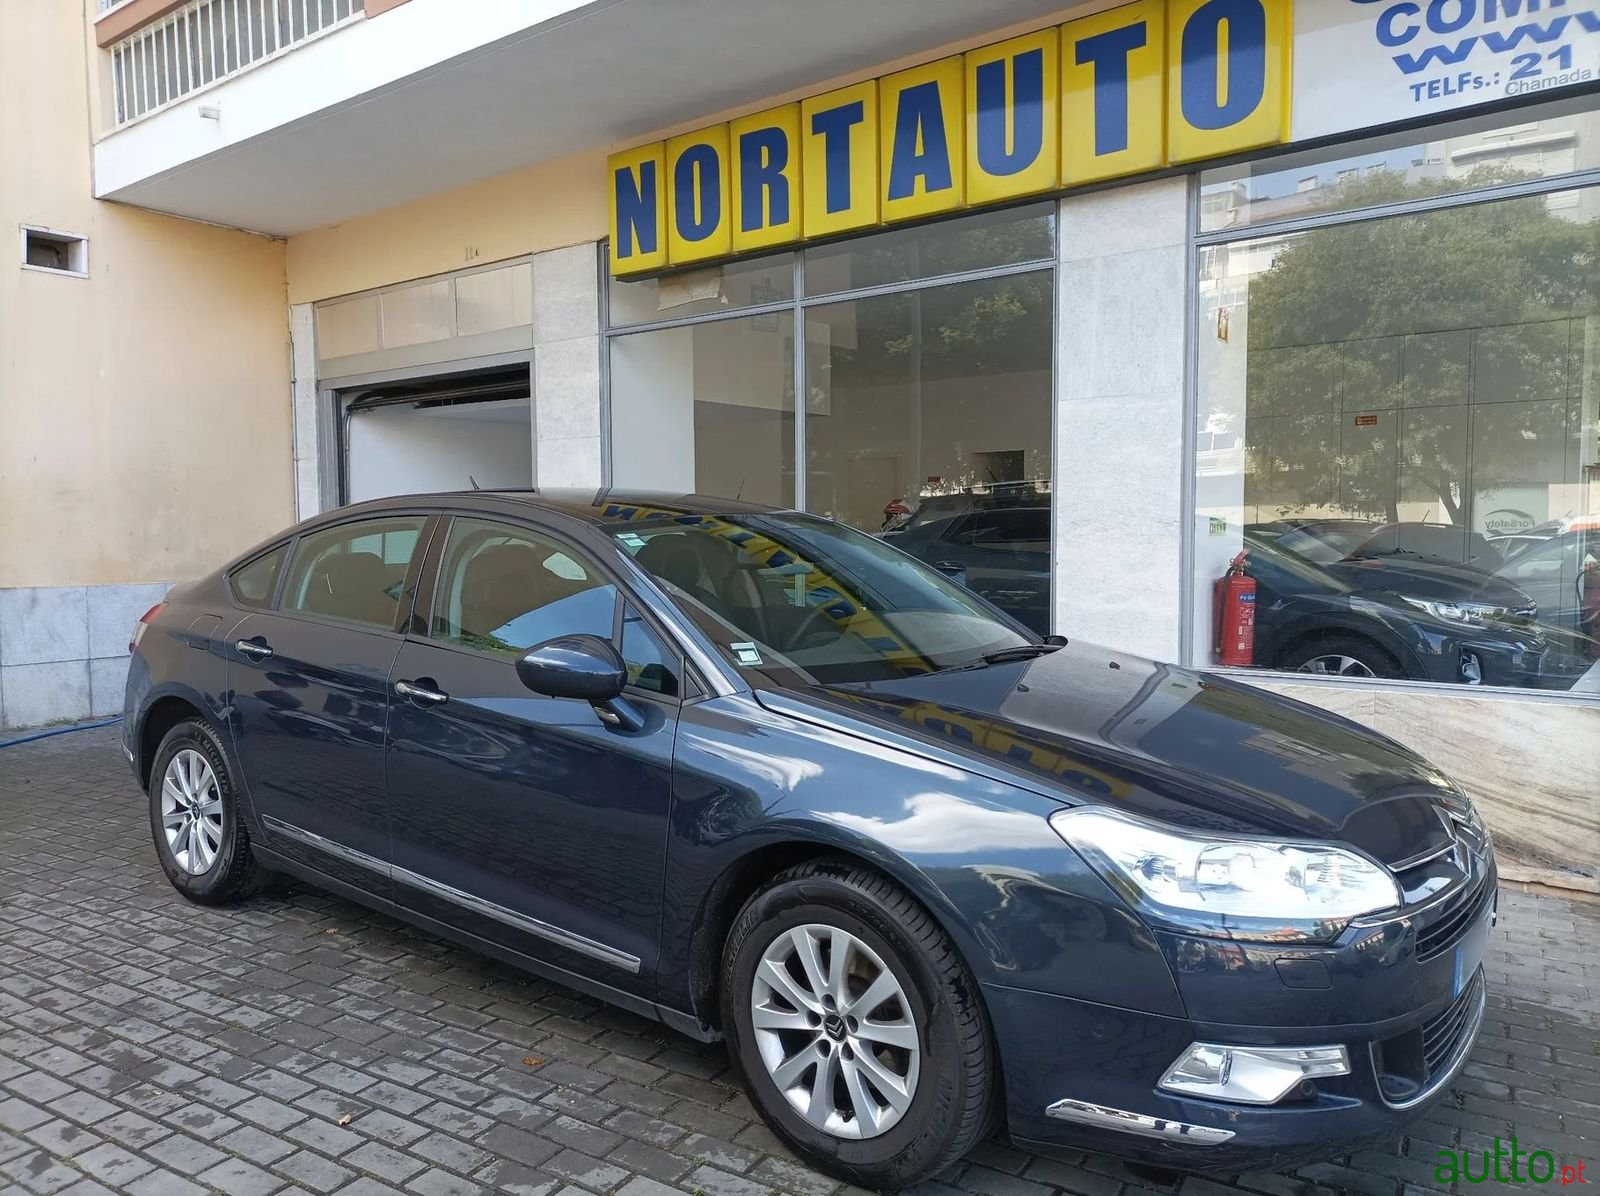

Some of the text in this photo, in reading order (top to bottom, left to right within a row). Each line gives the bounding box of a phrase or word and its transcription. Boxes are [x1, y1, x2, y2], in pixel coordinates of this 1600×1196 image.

[1504, 67, 1591, 96] Chamada
[1510, 44, 1572, 81] 21
[614, 0, 1266, 260] NORTAUTO
[202, 738, 231, 795] MICHELIN
